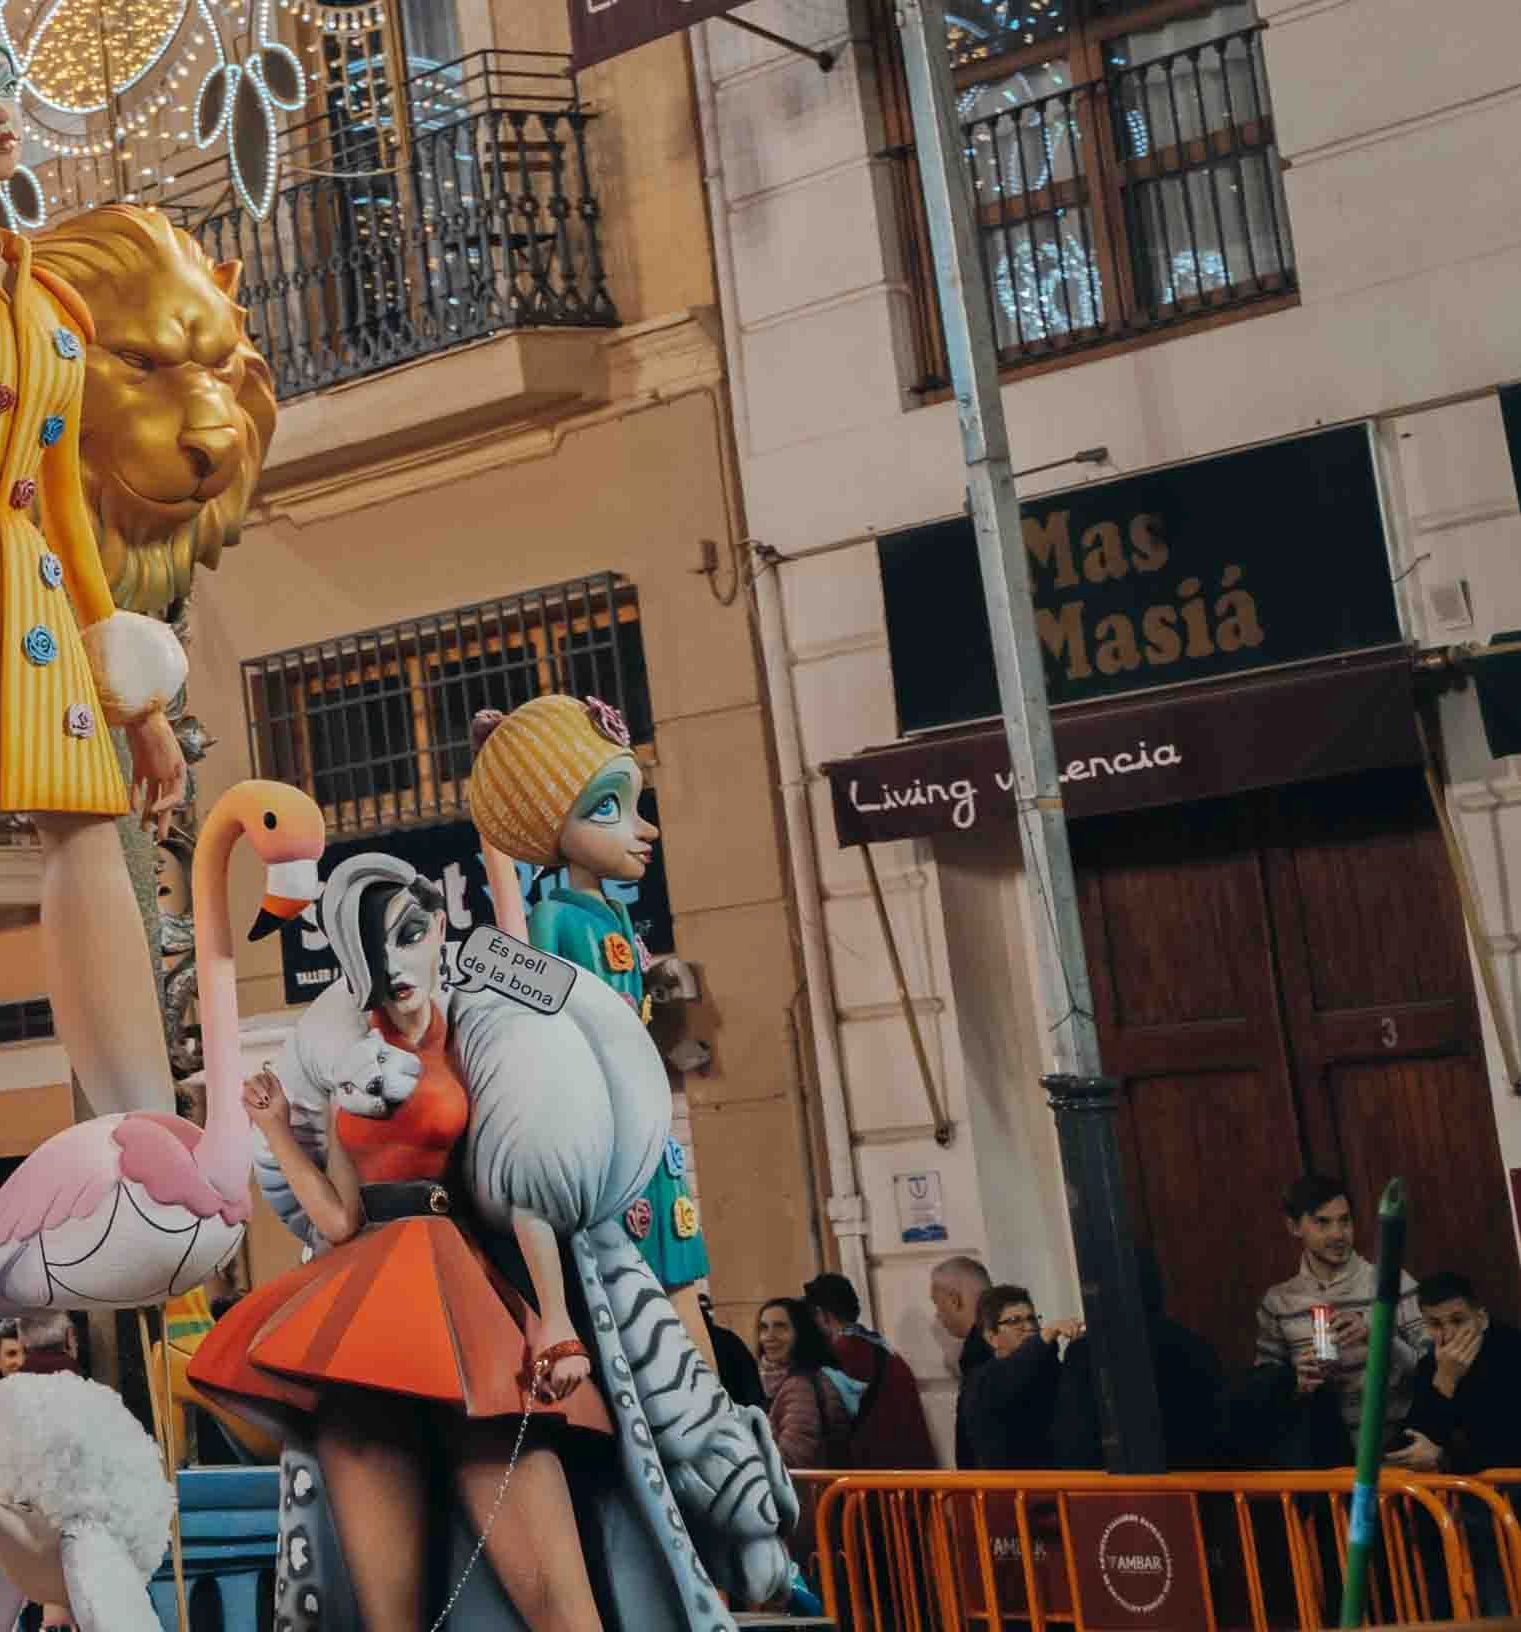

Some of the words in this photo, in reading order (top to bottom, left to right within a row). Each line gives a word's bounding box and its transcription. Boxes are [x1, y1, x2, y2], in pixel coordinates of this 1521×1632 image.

[1020, 510, 1170, 589] Mas
[1036, 564, 1265, 680] Masiá
[849, 778, 978, 829] Living
[488, 935, 509, 958] És
[511, 949, 548, 976] pell
[462, 956, 486, 974] de
[489, 962, 505, 983] la
[508, 974, 554, 1007] bona
[1380, 1016, 1398, 1048] 3
